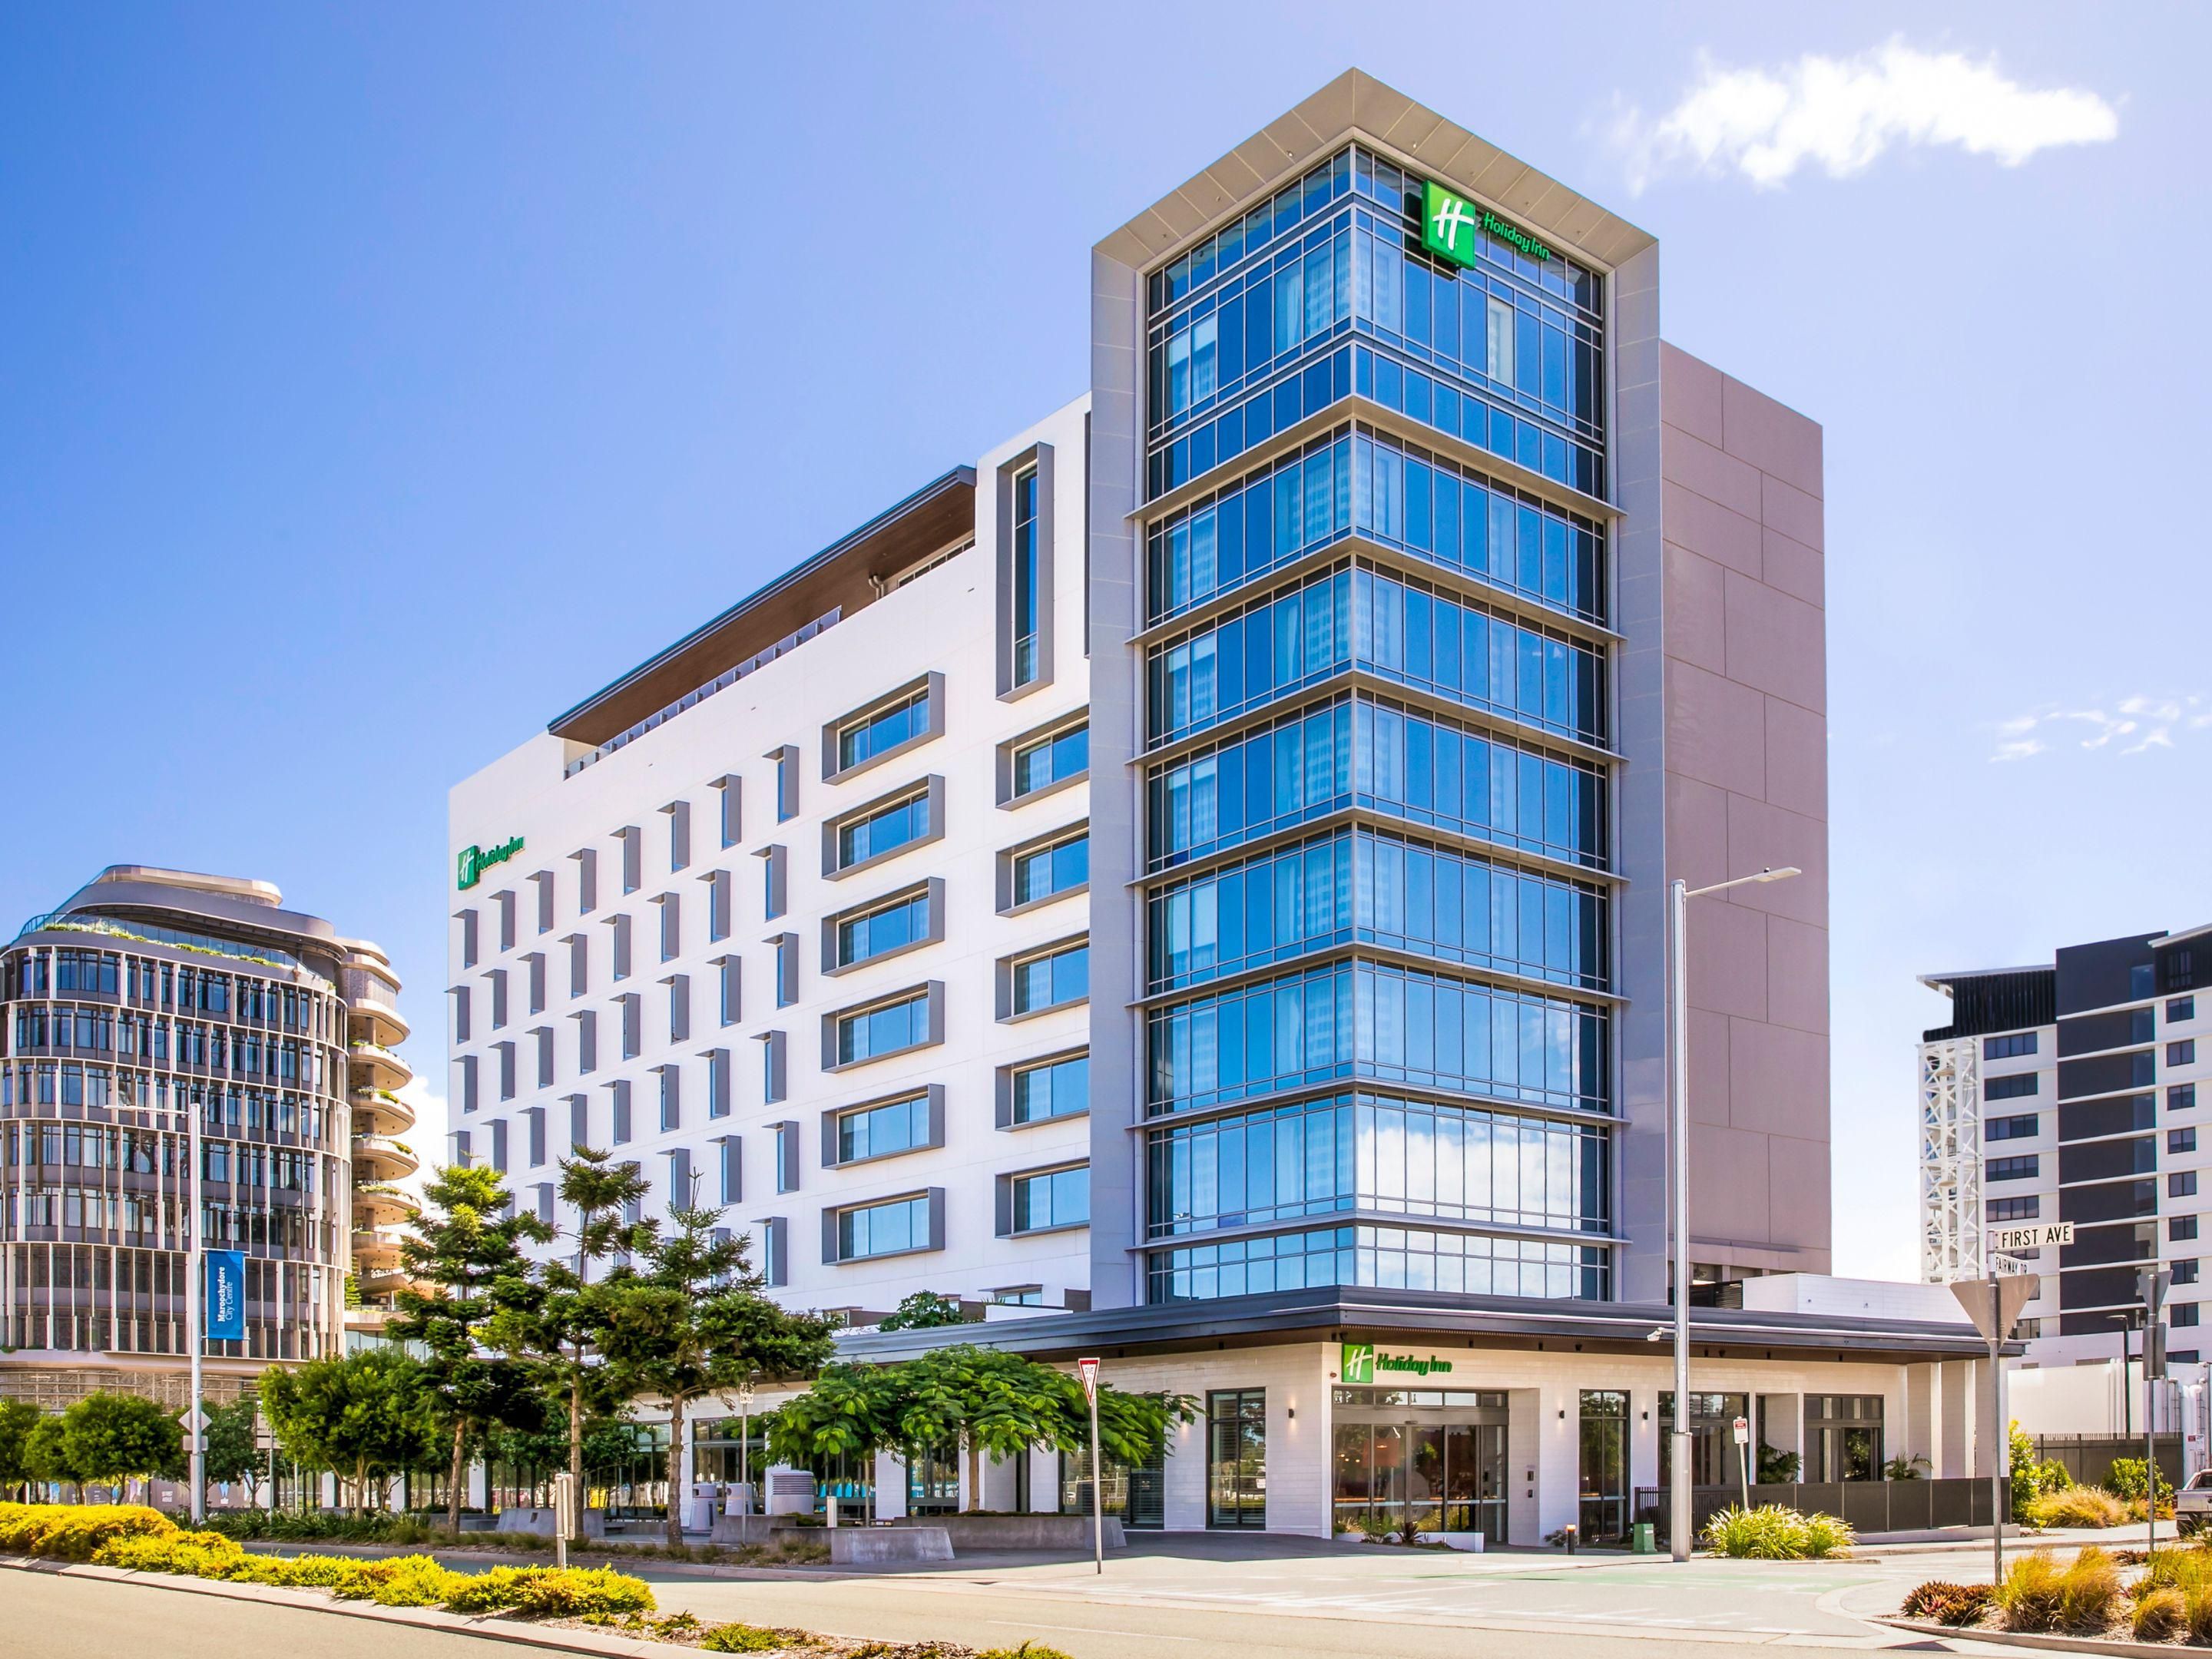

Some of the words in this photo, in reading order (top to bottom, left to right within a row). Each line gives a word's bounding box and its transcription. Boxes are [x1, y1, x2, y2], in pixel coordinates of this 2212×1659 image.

[1484, 212, 1531, 253] Holiday
[1532, 237, 1550, 260] Inn
[476, 845, 509, 872] Holiday
[509, 836, 525, 855] Inn
[2002, 1229, 2038, 1247] FIRST
[2046, 1225, 2071, 1243] AVE
[1995, 1257, 2018, 1276] FAIRWAY
[217, 1267, 227, 1322] Maroochydore
[226, 1306, 235, 1320] City
[1376, 1353, 1429, 1376] Holiday
[1430, 1355, 1452, 1373] Inn
